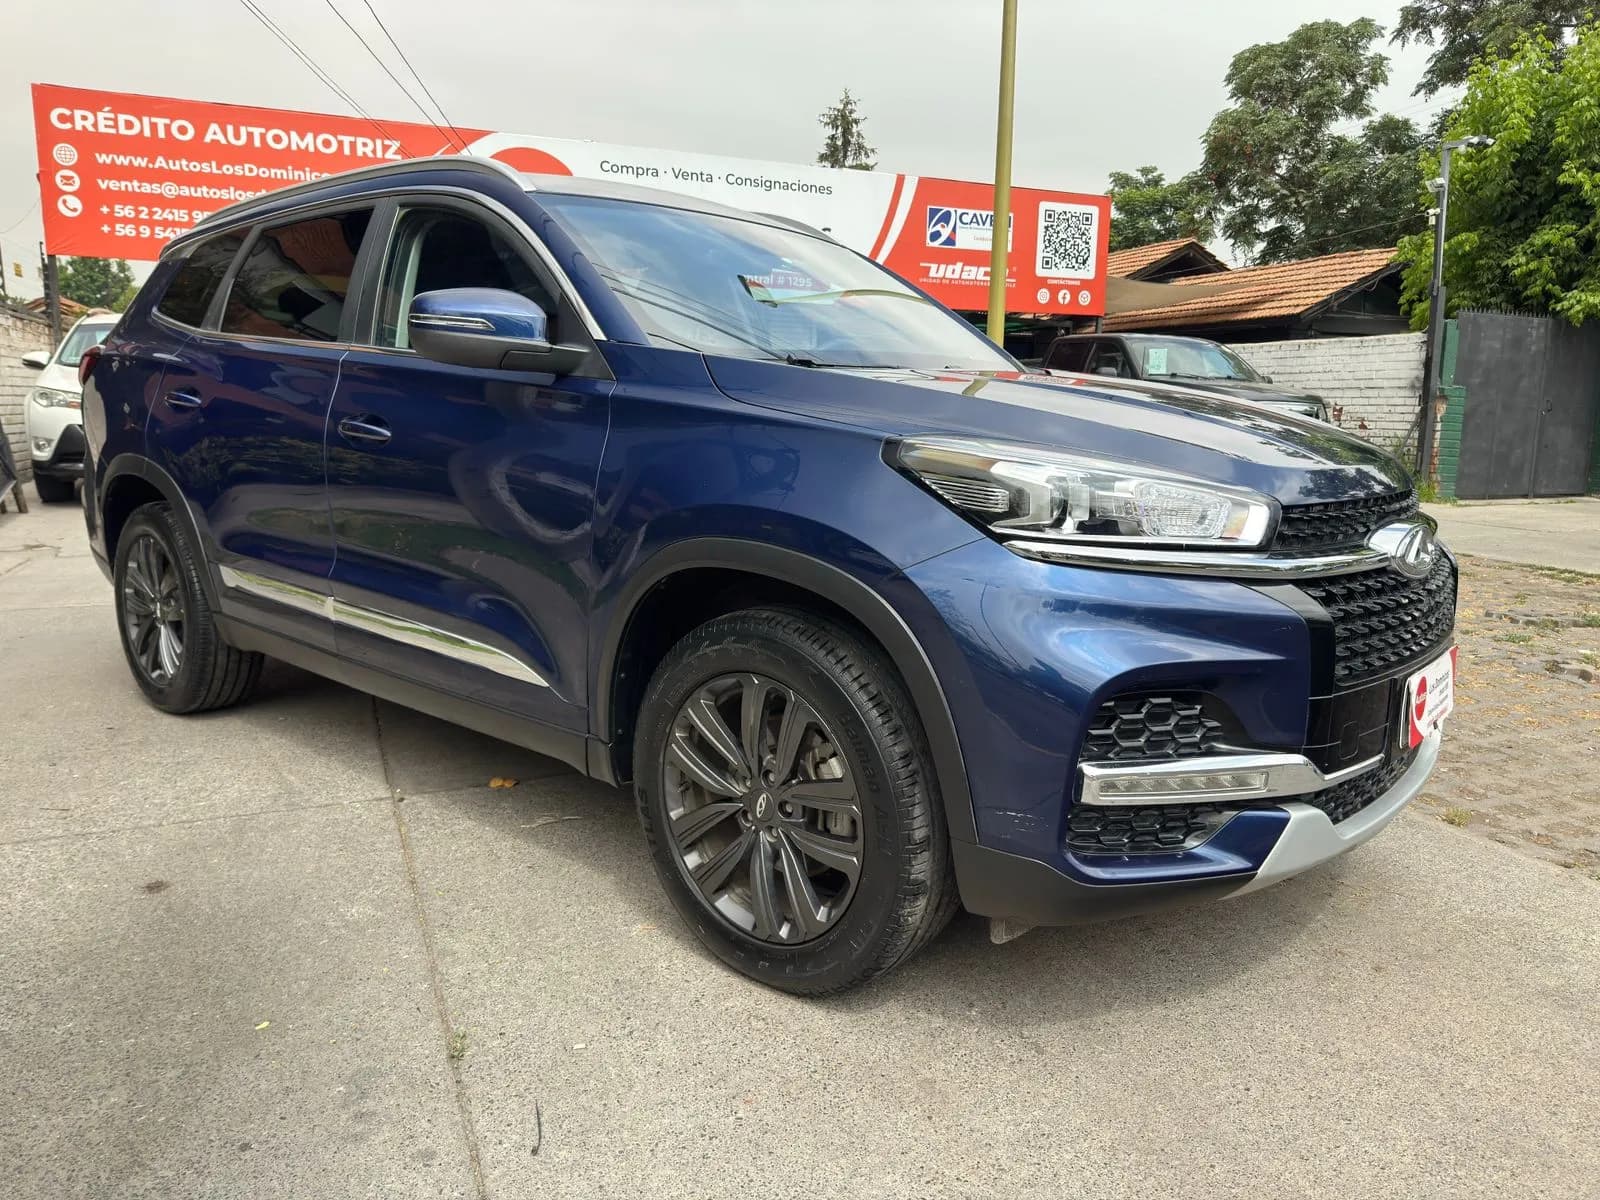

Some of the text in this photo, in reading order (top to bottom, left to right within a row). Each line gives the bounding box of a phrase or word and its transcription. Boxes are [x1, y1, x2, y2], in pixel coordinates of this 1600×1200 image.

[50, 106, 402, 161] CRÉDITO AUTOMOTRIZ
[599, 160, 834, 196] Compra Venta Consignaciones
[100, 205, 110, 214] +
[113, 204, 135, 218] 56
[138, 206, 149, 219] 2
[151, 207, 189, 222] 2415
[101, 224, 111, 233] +
[114, 224, 136, 237] 56
[139, 226, 151, 238] 9
[788, 275, 813, 288] 1295
